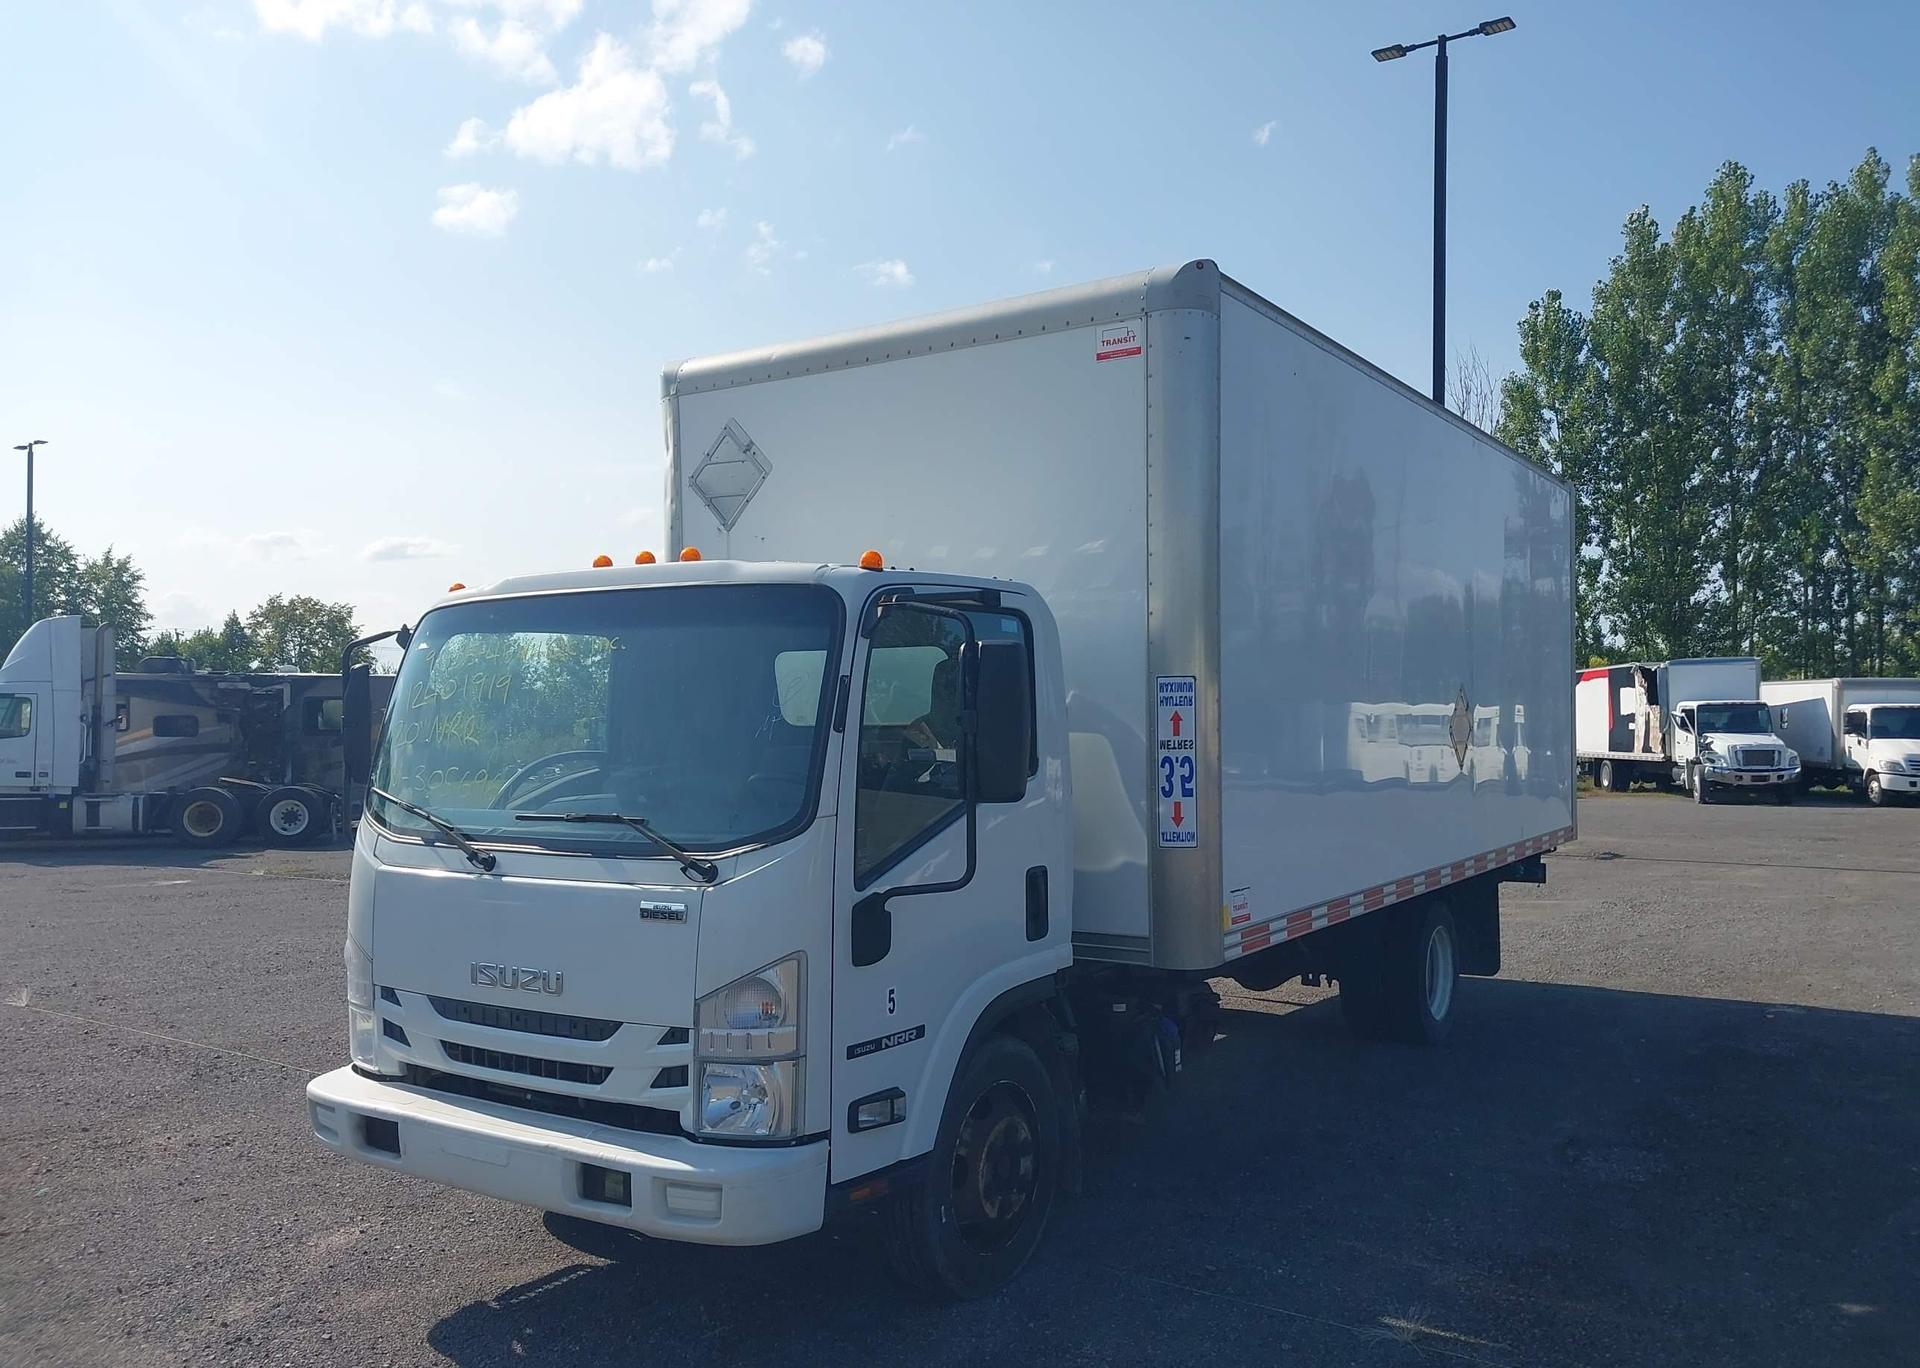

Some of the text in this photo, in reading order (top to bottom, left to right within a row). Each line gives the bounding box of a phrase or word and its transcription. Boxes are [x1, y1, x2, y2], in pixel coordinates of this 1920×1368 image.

[1101, 335, 1136, 346] TRANSIT
[640, 910, 684, 921] DIESEL
[470, 961, 564, 997] ISUZU
[888, 988, 896, 1014] 5
[854, 1029, 917, 1055] ISUZU NRR
